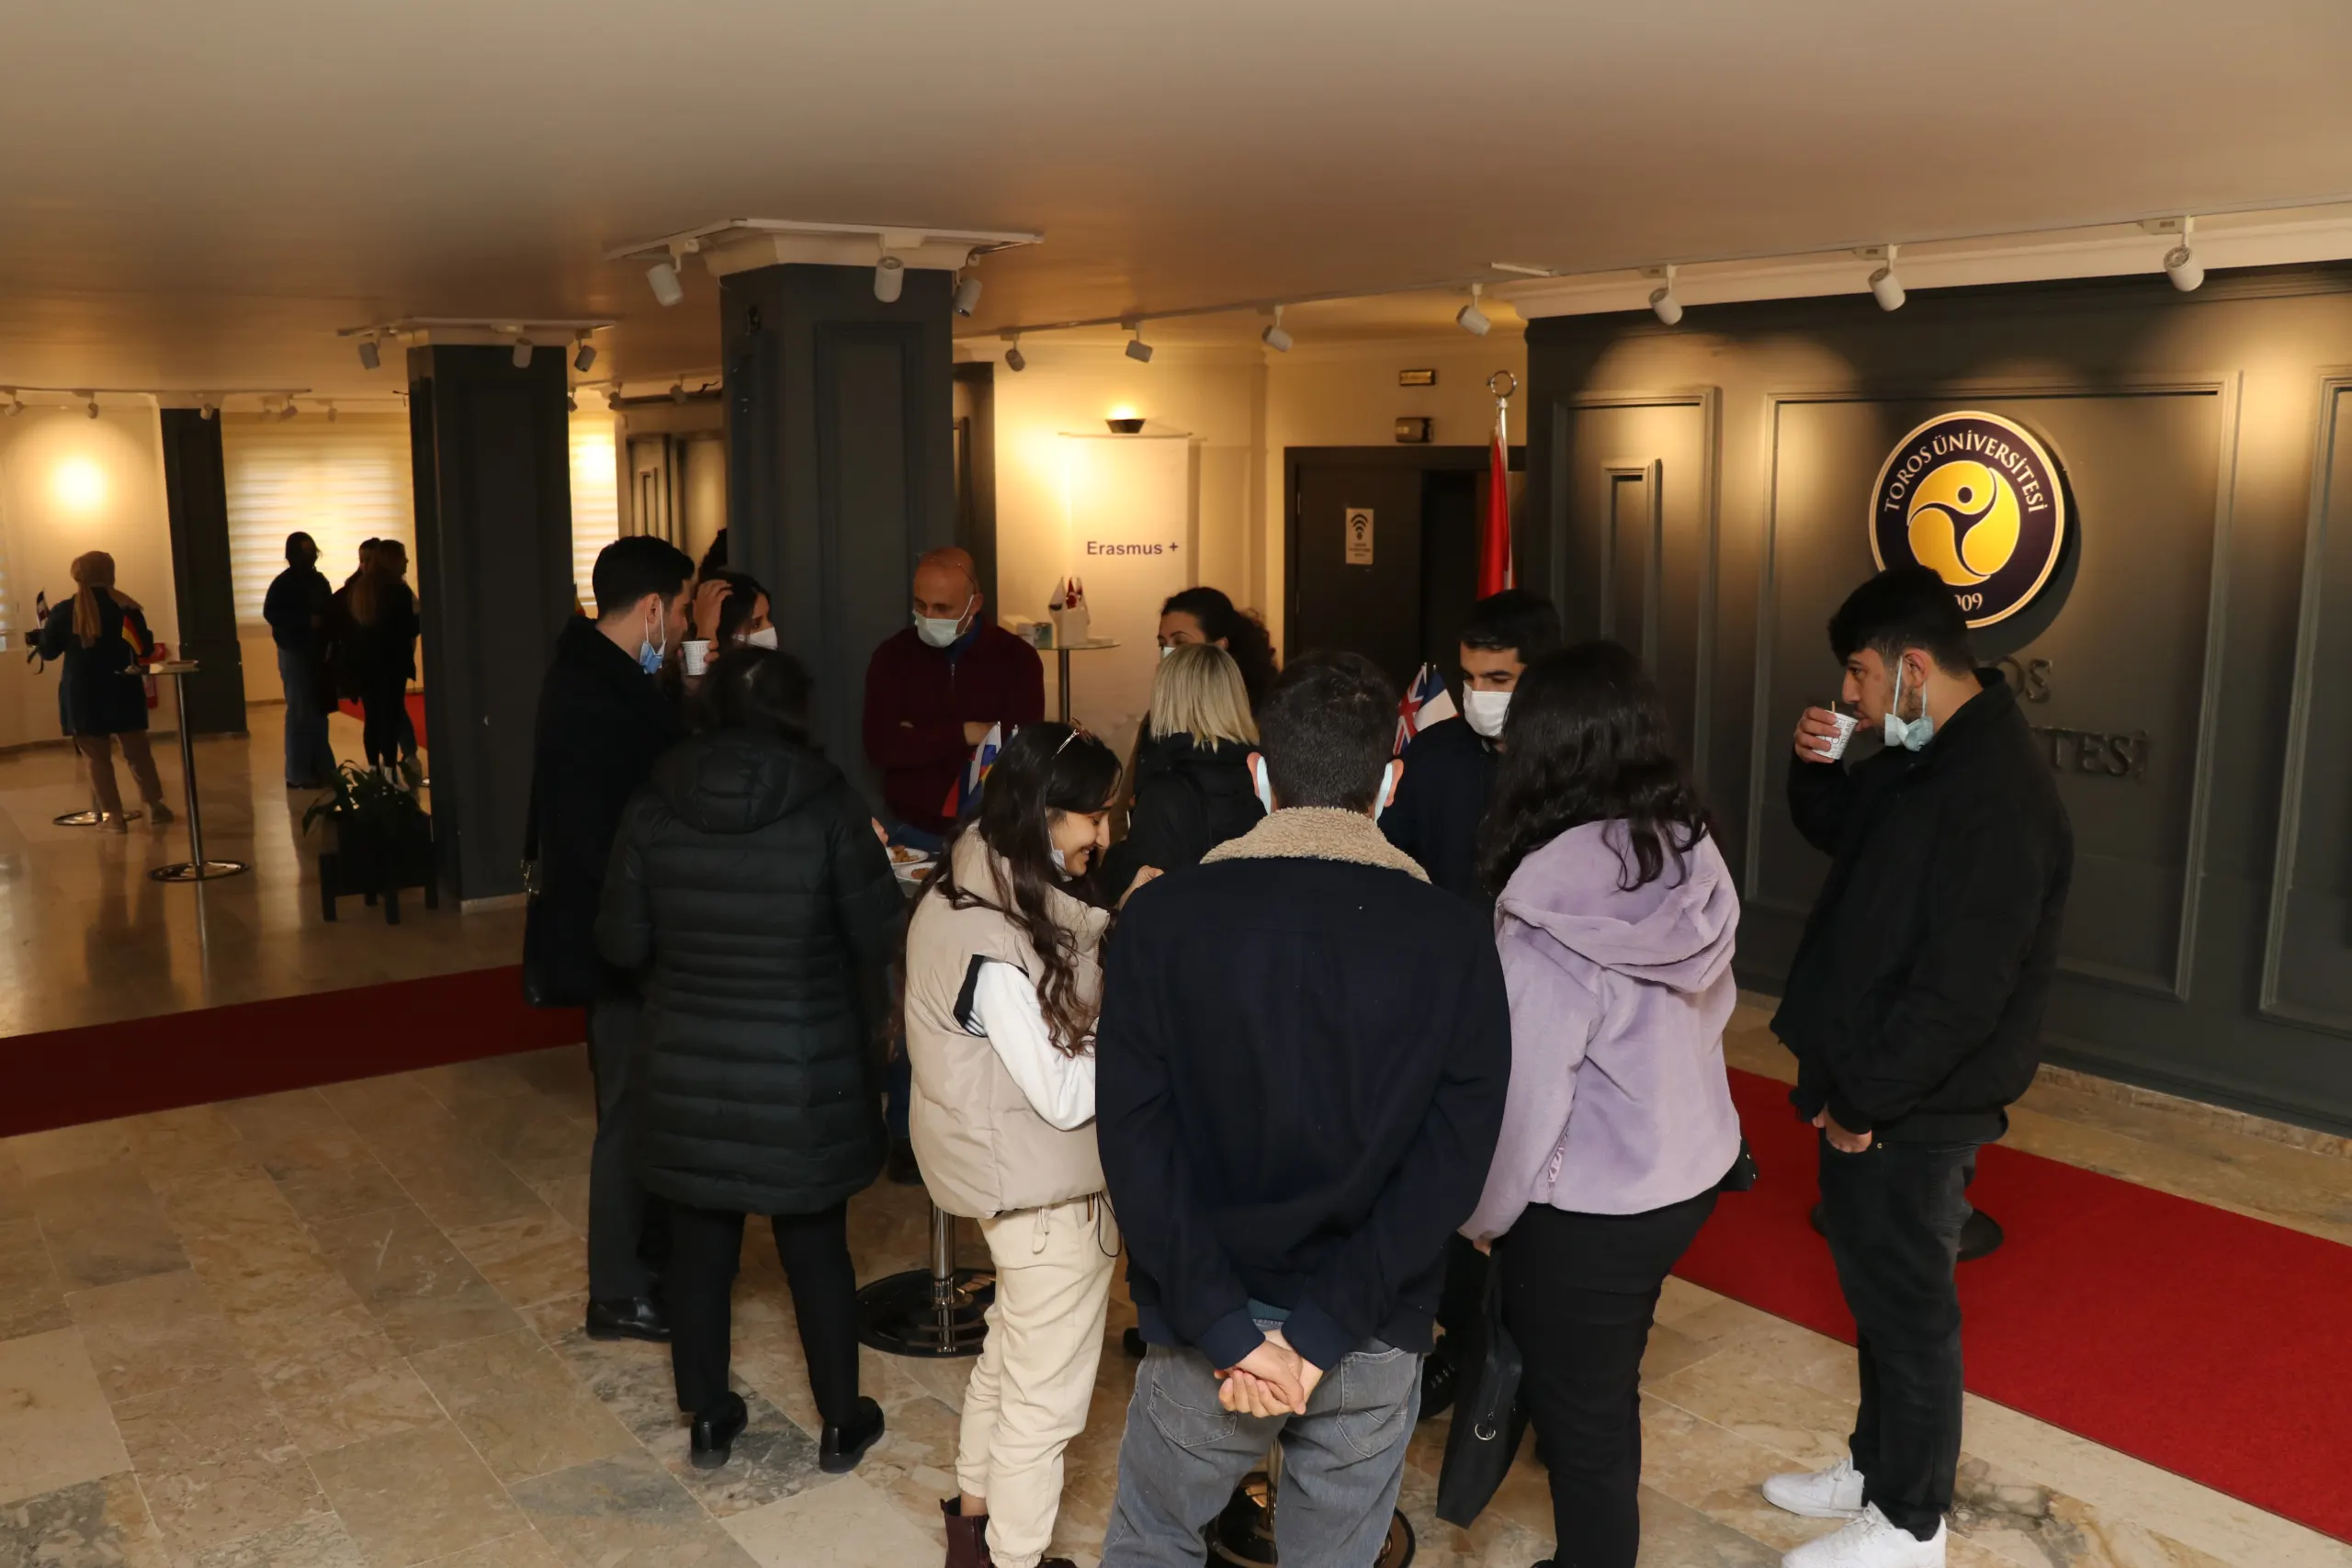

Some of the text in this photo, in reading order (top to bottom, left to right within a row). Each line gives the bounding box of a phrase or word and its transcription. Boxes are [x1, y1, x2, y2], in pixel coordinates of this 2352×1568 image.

[1884, 429, 2048, 514] TOROS ÜNİVERSİTESİ
[1087, 541, 1162, 555] Erasmus
